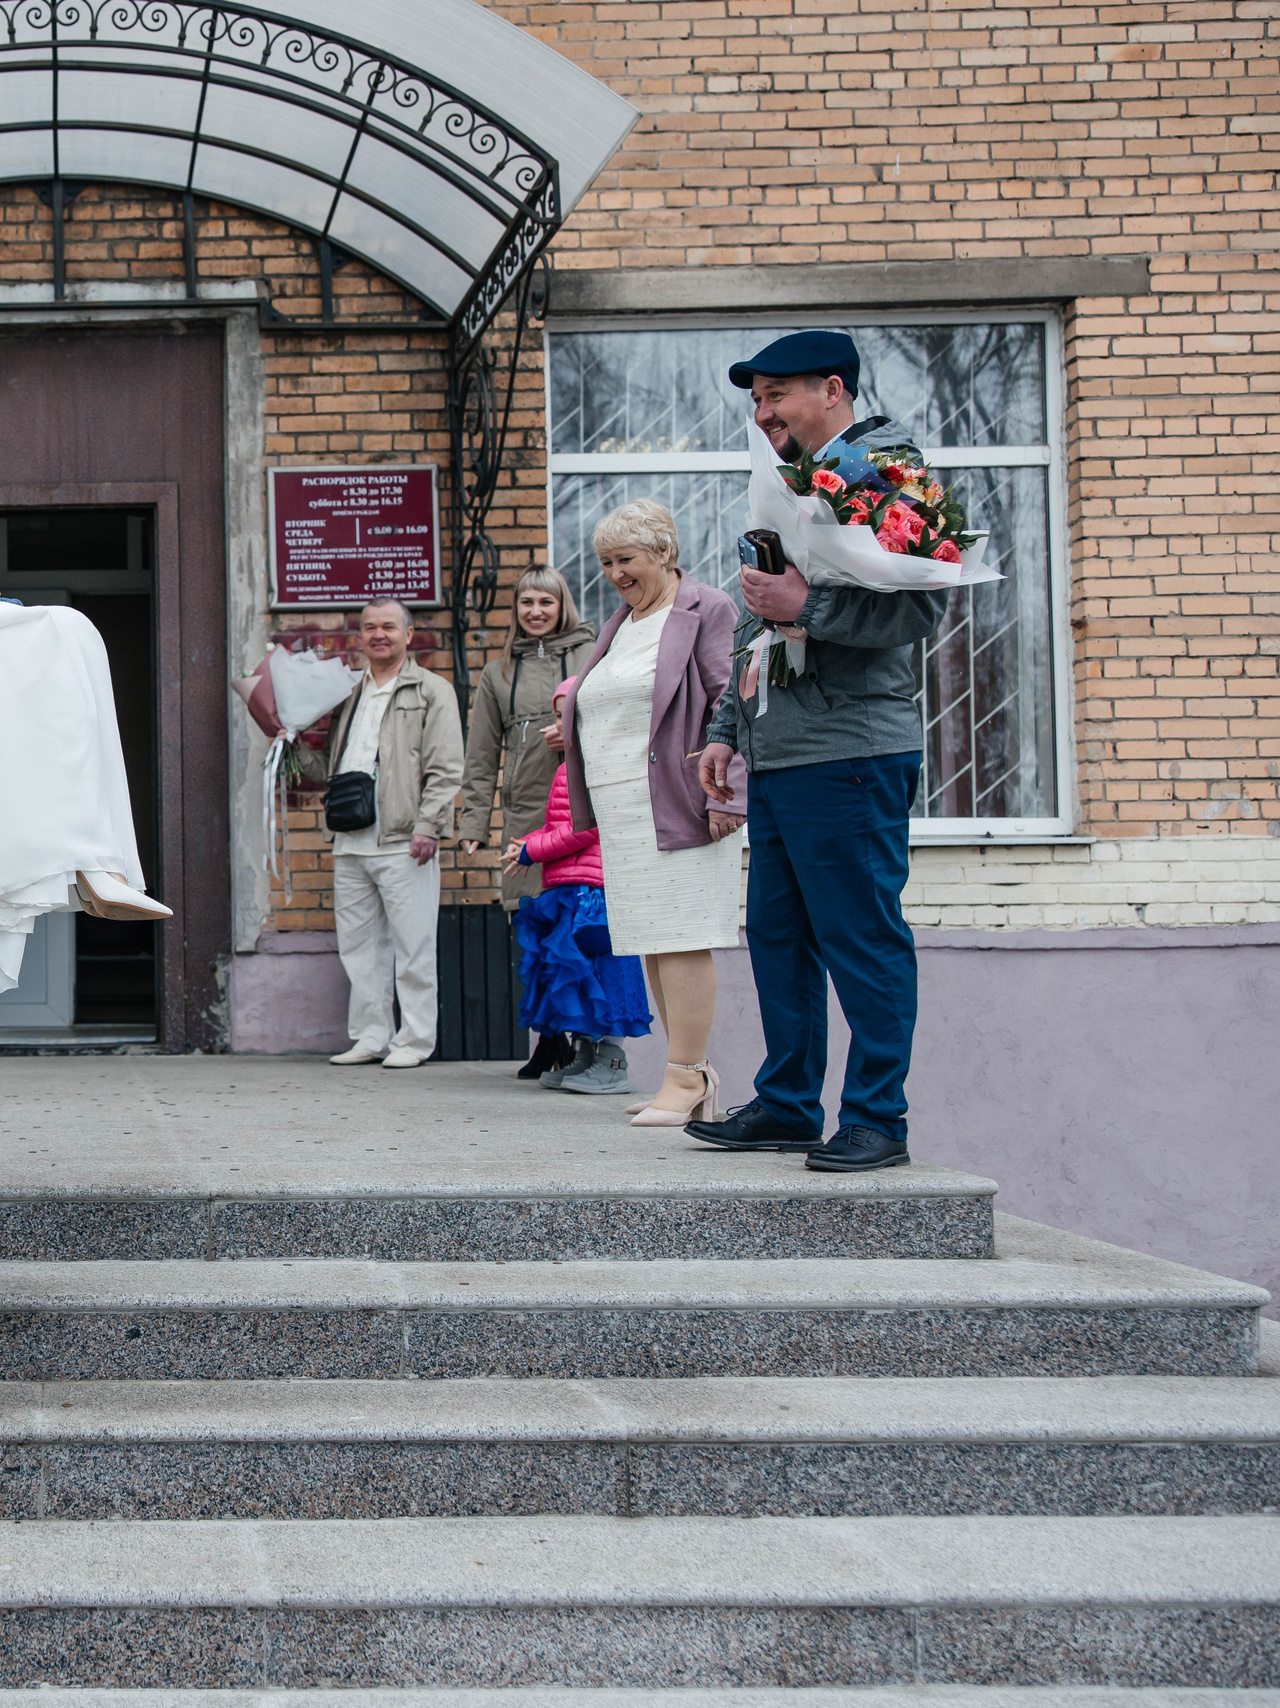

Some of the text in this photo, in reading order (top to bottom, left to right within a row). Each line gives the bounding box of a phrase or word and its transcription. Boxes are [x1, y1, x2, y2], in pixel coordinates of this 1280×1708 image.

[302, 475, 408, 486] РАСПОРЯДОК РАБОТЫ
[381, 487, 402, 495] 17.30
[285, 520, 326, 528] ВТОРНИК
[285, 529, 314, 538] СРЕДА
[406, 525, 428, 534] 16.00
[285, 538, 324, 546] ЧЕТВЕРГ
[286, 562, 332, 571] ПЯТНИЦА
[407, 559, 429, 568] 16.00
[286, 573, 327, 582] СУББОТА
[407, 570, 429, 579] 15.30
[408, 581, 430, 589] 13.45
